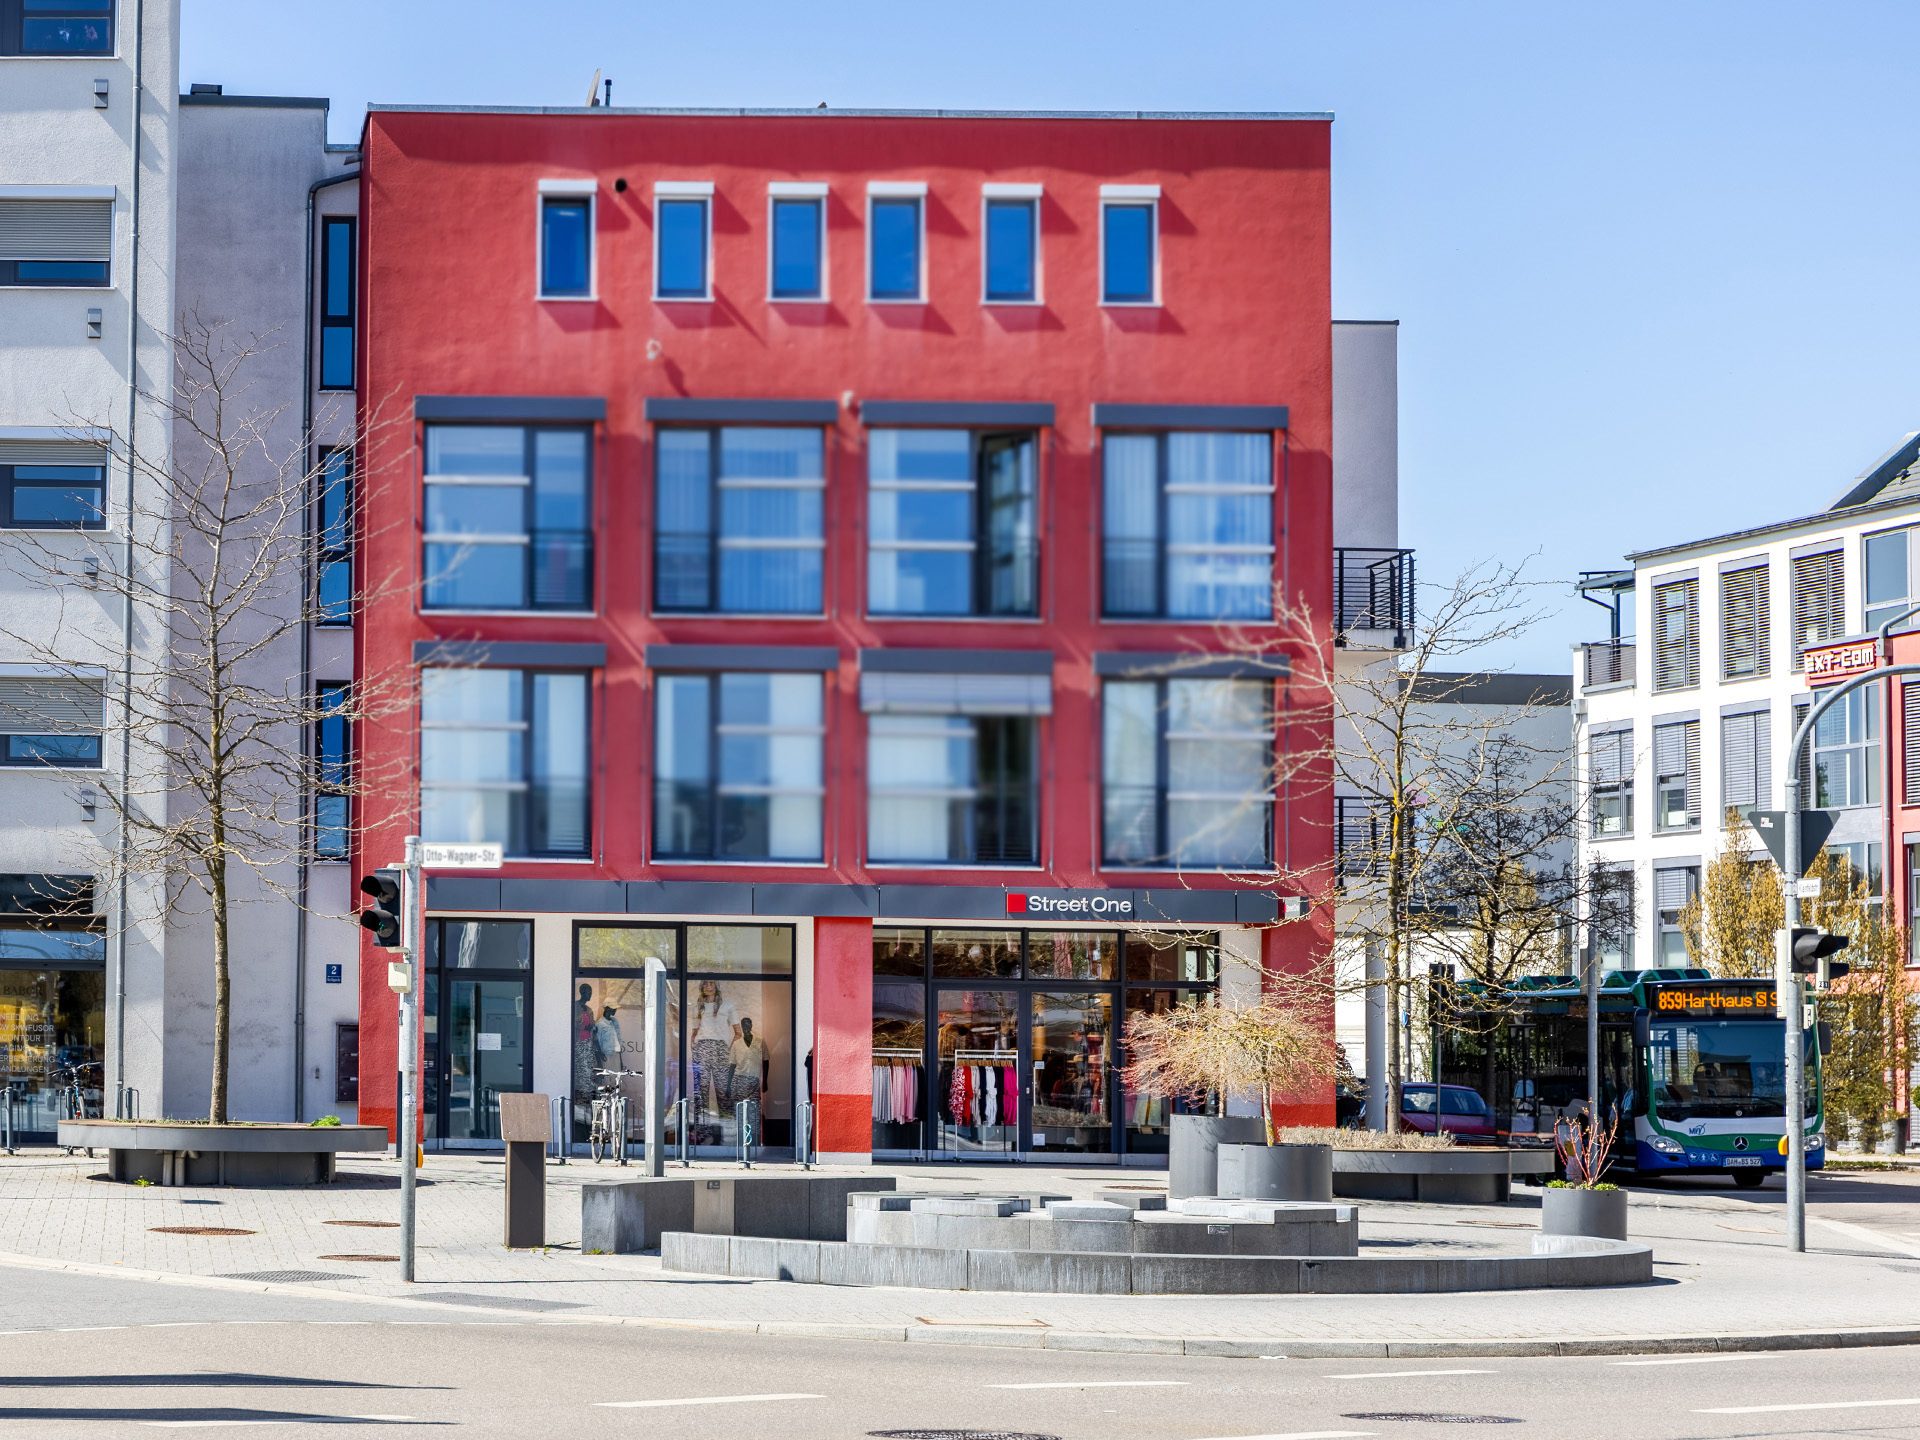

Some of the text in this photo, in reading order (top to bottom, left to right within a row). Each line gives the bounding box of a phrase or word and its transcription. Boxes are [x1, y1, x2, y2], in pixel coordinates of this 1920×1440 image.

[425, 849, 498, 864] Otto-Wagner-Str.
[1028, 895, 1132, 913] Street One
[331, 965, 337, 975] 2
[1659, 991, 1682, 1010] 859
[1683, 992, 1753, 1008] Harthaus
